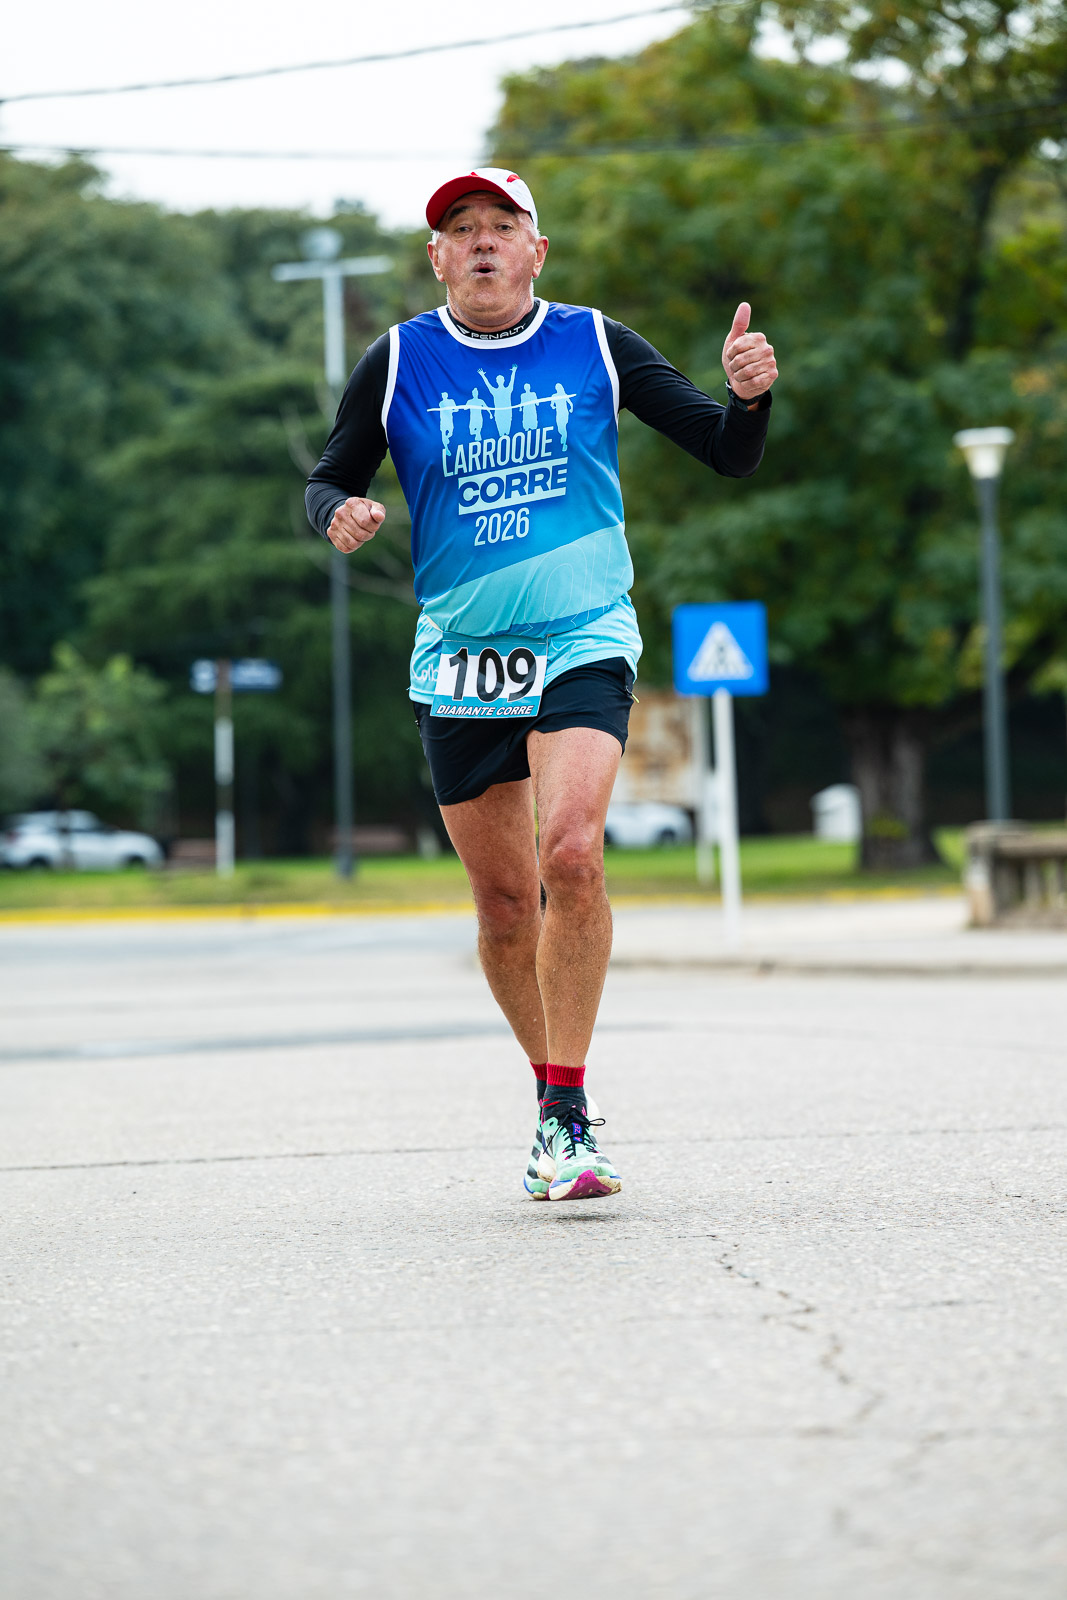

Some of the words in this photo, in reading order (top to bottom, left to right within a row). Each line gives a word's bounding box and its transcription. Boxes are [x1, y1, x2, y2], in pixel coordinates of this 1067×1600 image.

[471, 323, 526, 340] PENALTY
[442, 426, 554, 478] LARROQUE
[458, 466, 568, 508] CORRE
[474, 507, 530, 546] 2026
[449, 647, 537, 703] 109
[436, 704, 497, 716] DIAMANTE
[496, 705, 534, 716] CORRE
